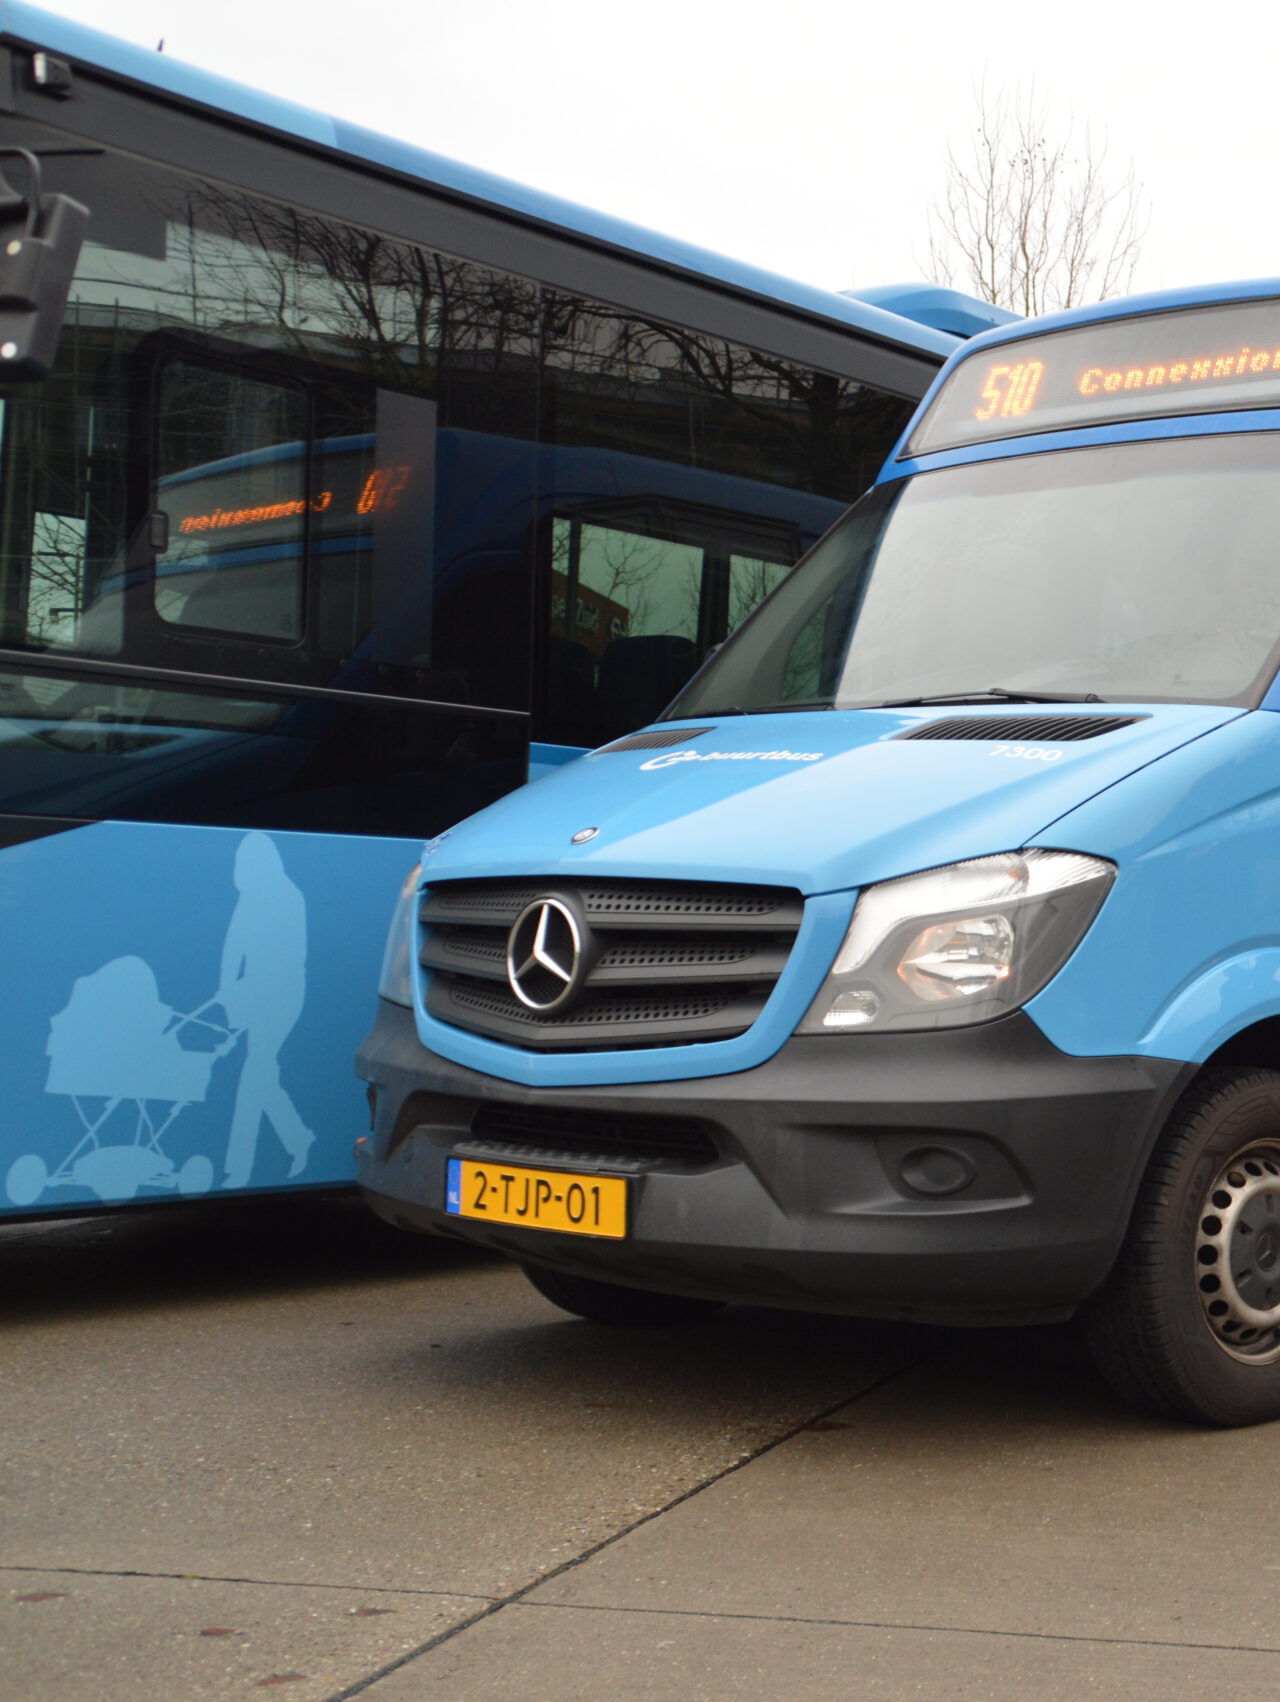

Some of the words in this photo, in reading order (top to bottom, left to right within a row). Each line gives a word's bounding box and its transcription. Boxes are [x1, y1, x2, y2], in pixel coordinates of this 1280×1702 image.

[976, 361, 1043, 420] 510
[701, 750, 825, 761] buurtbus
[988, 745, 1063, 760] 7300
[473, 1171, 599, 1226] 2-TJP-01
